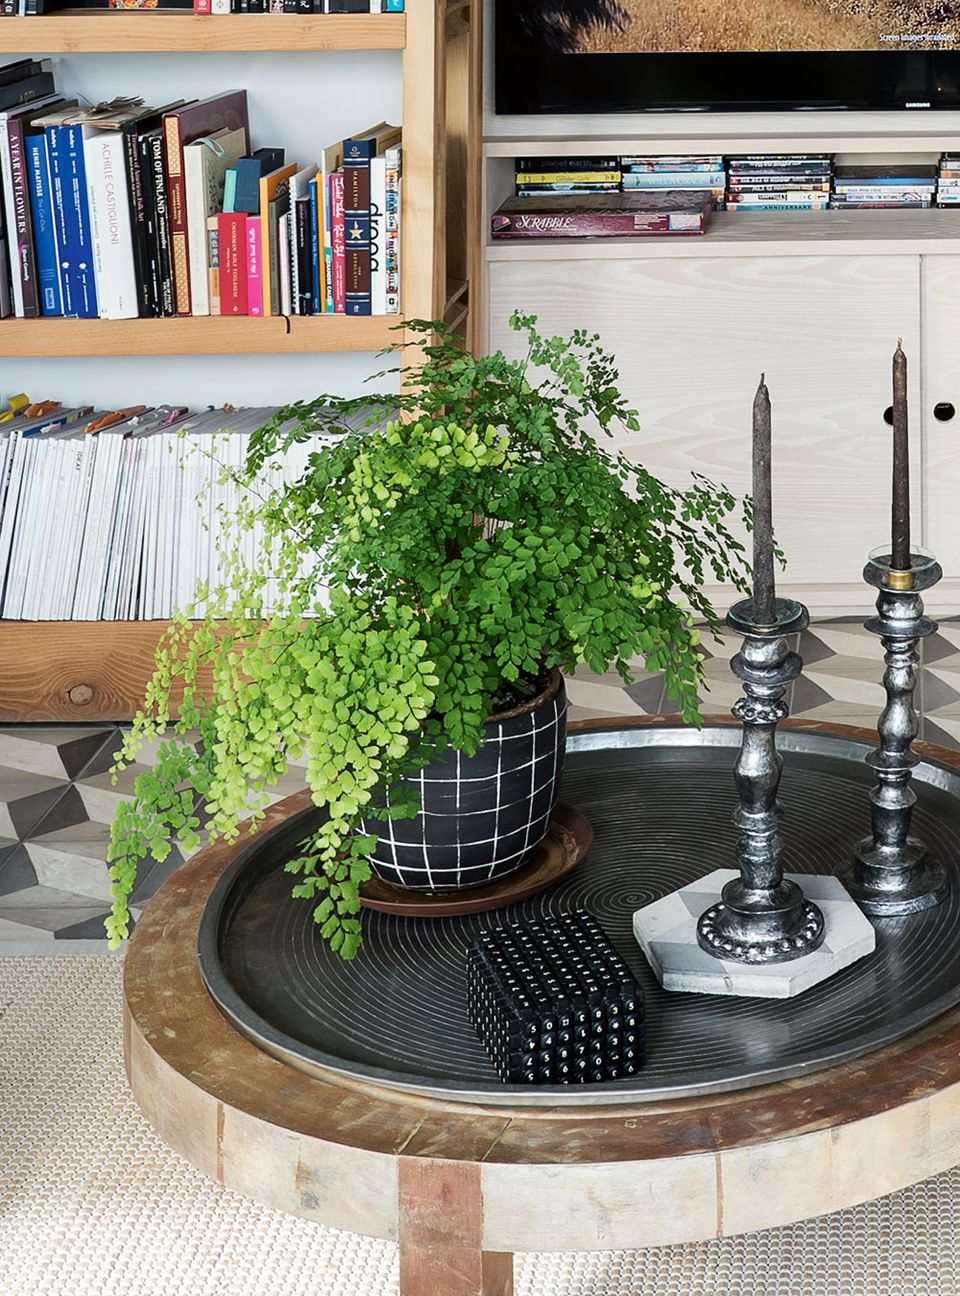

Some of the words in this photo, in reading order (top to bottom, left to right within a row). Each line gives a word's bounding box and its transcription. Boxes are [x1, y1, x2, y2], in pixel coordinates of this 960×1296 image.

[878, 33, 900, 42] Screen
[900, 33, 924, 43] images
[10, 134, 19, 142] A
[131, 133, 139, 160] Treasures
[11, 144, 21, 170] YEAR
[32, 146, 41, 168] HENRI
[152, 140, 161, 160] TOM
[101, 142, 114, 181] ACHILLE
[133, 161, 140, 169] of
[154, 161, 162, 174] OF
[540, 159, 568, 168] planet
[568, 159, 593, 167] earth
[14, 171, 22, 184] IN
[34, 168, 43, 197] MATISSE
[134, 168, 142, 197] American
[136, 197, 144, 210] Folk
[155, 174, 165, 214] FINLAND
[15, 185, 26, 234] FLOWERS
[105, 183, 119, 245] CASTIGLIONI
[159, 216, 168, 249] retrospective
[515, 216, 573, 231] SCRABBLE
[325, 254, 333, 285] ALEXANDER
[74, 451, 82, 471] IDEAT
